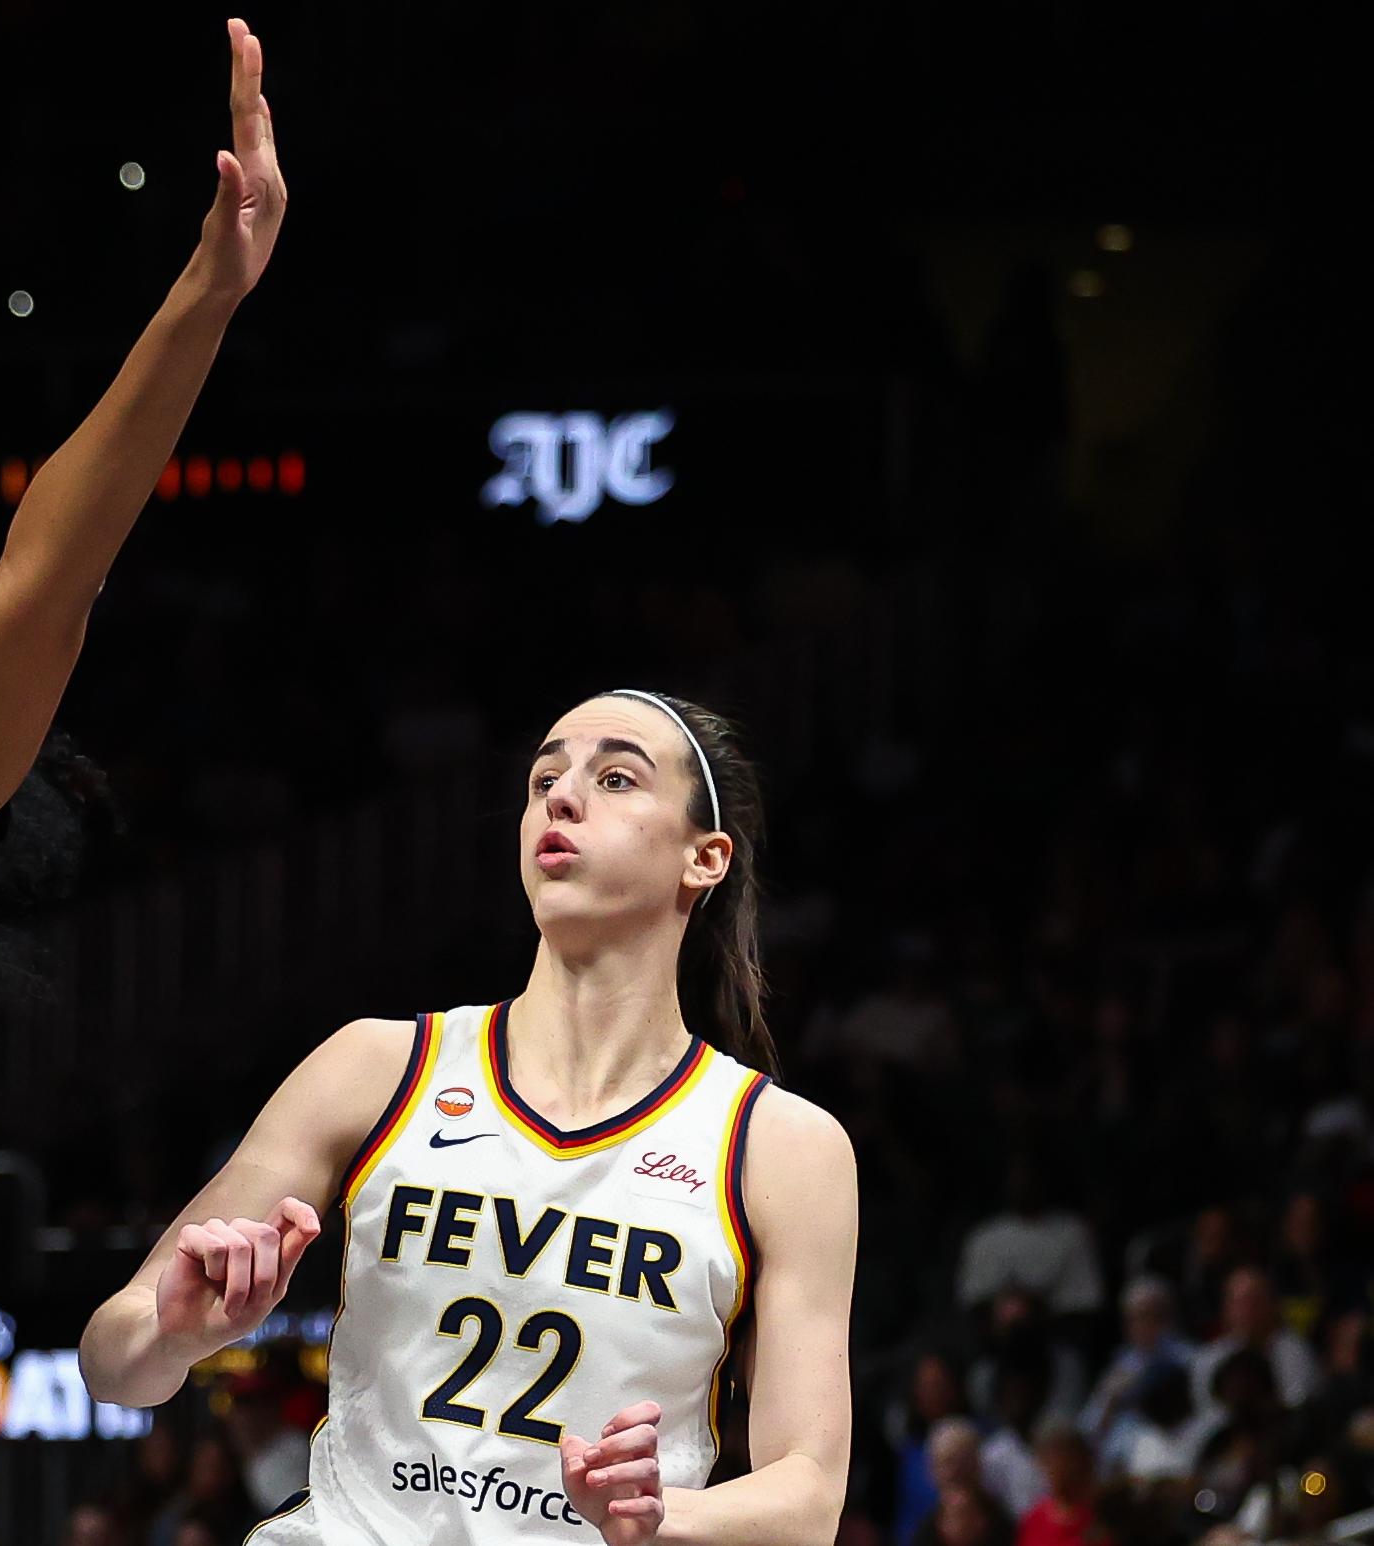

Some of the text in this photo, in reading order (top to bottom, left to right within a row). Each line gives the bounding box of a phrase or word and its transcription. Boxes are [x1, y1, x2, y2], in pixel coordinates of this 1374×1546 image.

[633, 1151, 707, 1194] Lilly
[380, 1184, 685, 1314] FEVER
[419, 1294, 586, 1447] 22
